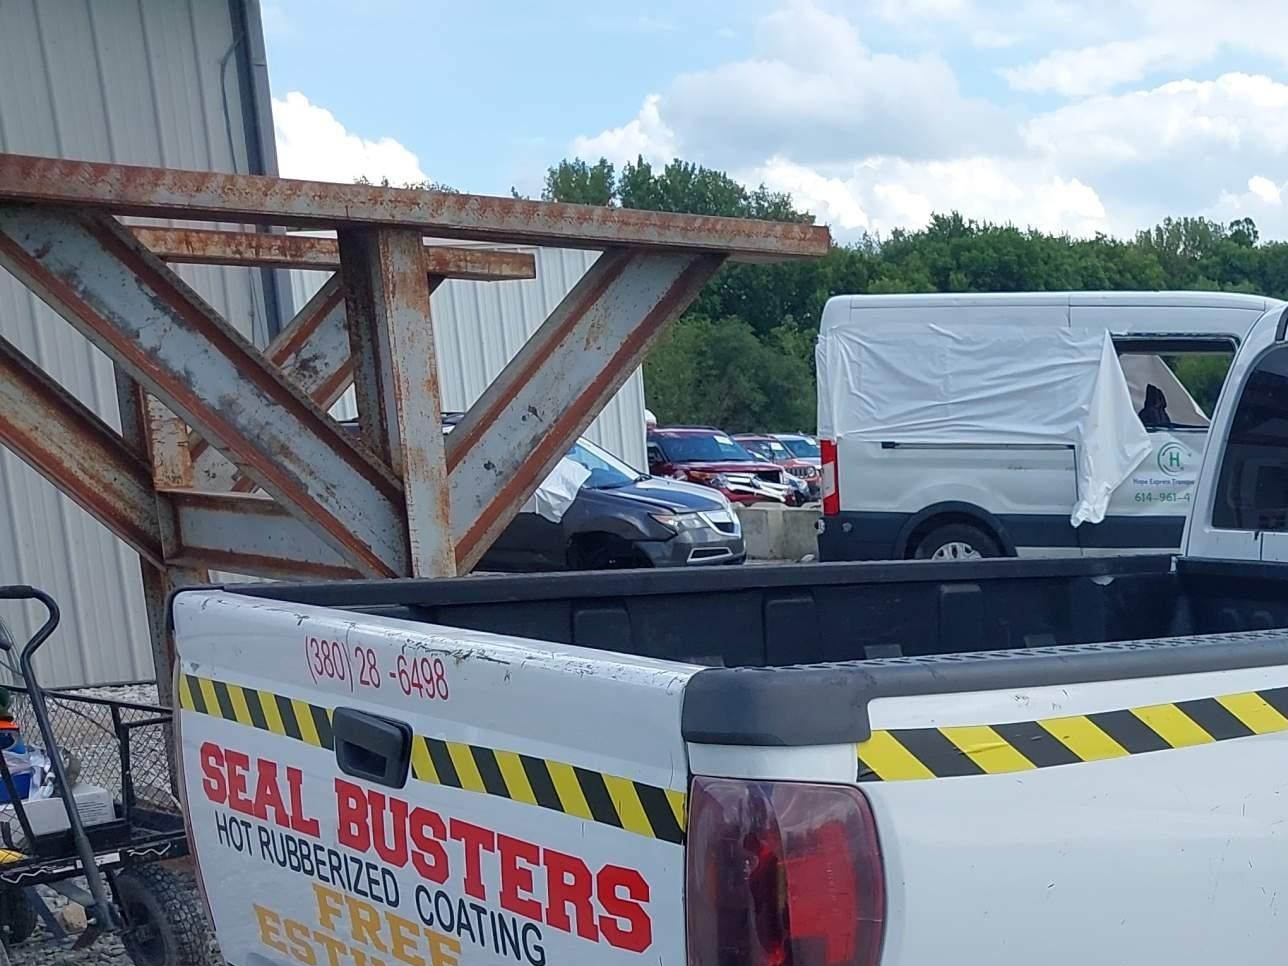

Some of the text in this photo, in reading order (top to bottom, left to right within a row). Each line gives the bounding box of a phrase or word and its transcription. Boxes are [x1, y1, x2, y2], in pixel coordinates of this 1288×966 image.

[389, 654, 449, 701] -6498
[200, 741, 653, 954] SEAL BUSTERS
[215, 810, 257, 857] HOT
[259, 826, 400, 908] RUBBERIZED
